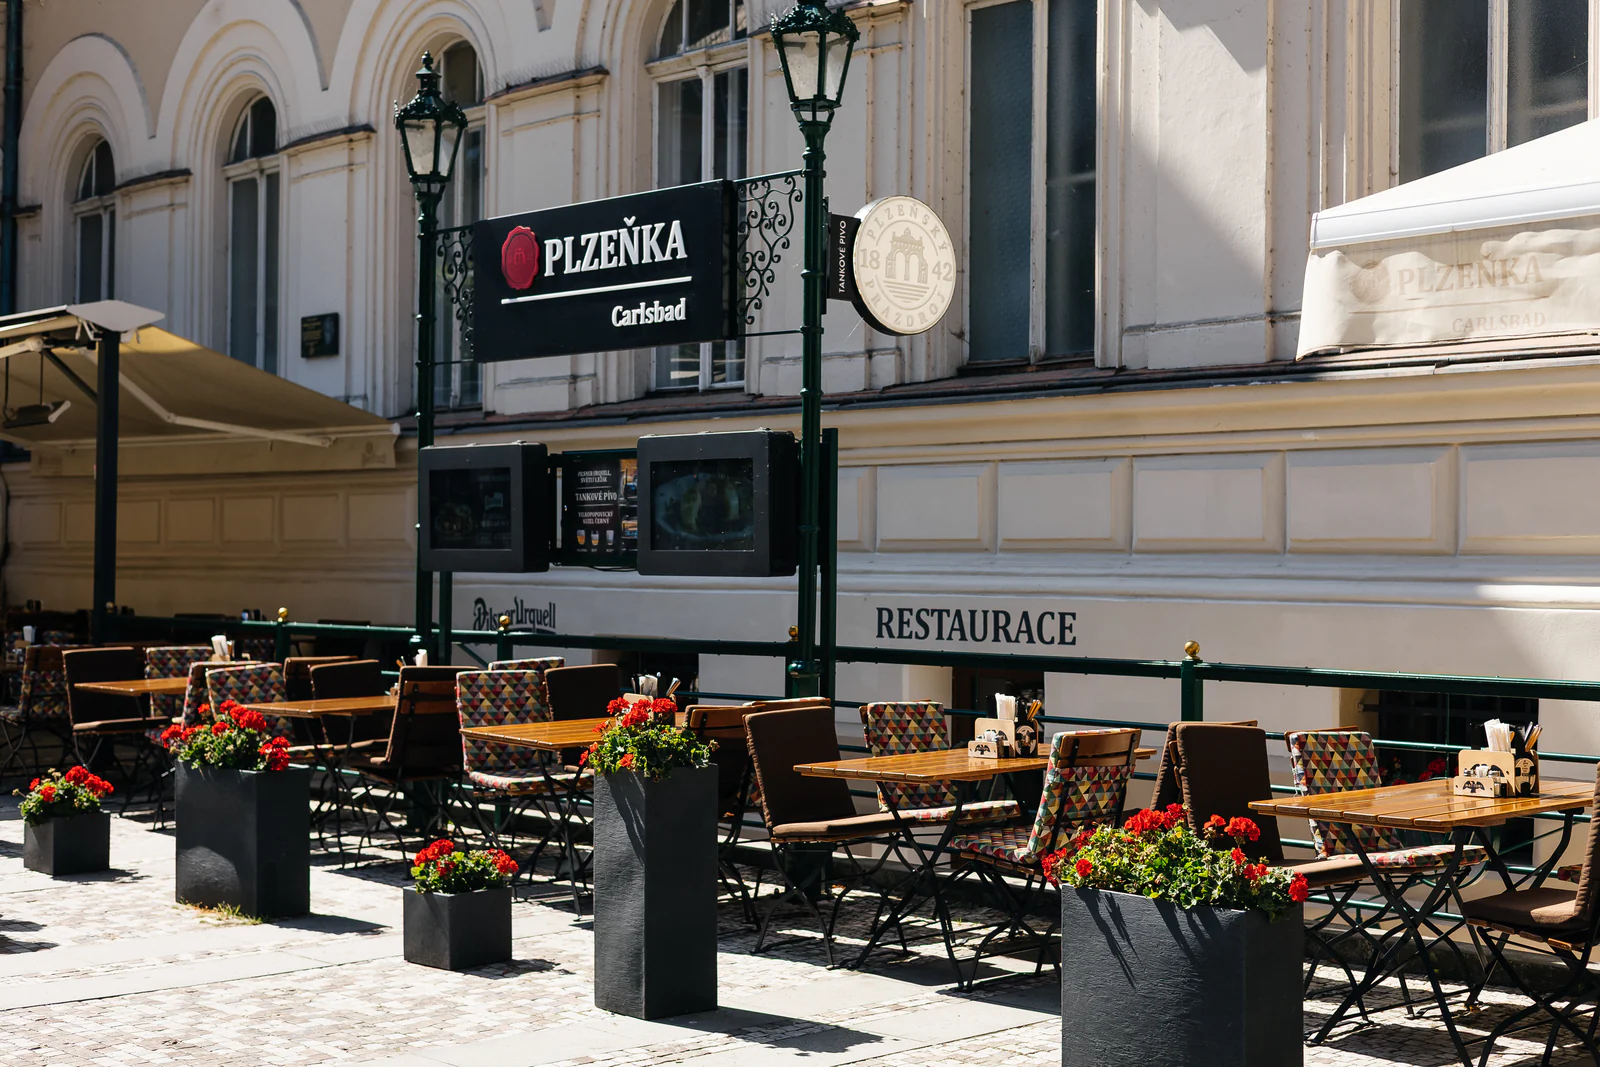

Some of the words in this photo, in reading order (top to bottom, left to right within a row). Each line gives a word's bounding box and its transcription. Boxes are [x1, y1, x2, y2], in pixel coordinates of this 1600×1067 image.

[839, 220, 847, 245] PIVO
[867, 203, 950, 250] PLZEŇSKÝ
[544, 216, 688, 277] PLZEŇKA
[860, 248, 881, 269] 18
[932, 261, 953, 281] 42
[838, 248, 846, 293] TANKOVÉ
[1397, 252, 1545, 295] PLZEŇKA
[611, 297, 687, 327] Carlsbad
[865, 279, 945, 327] PRAZDROJ
[1453, 313, 1546, 333] CARLSBAD
[575, 491, 602, 501] TANKOVÉ
[514, 596, 556, 632] Urquell
[876, 607, 1077, 646] RESTAURACE
